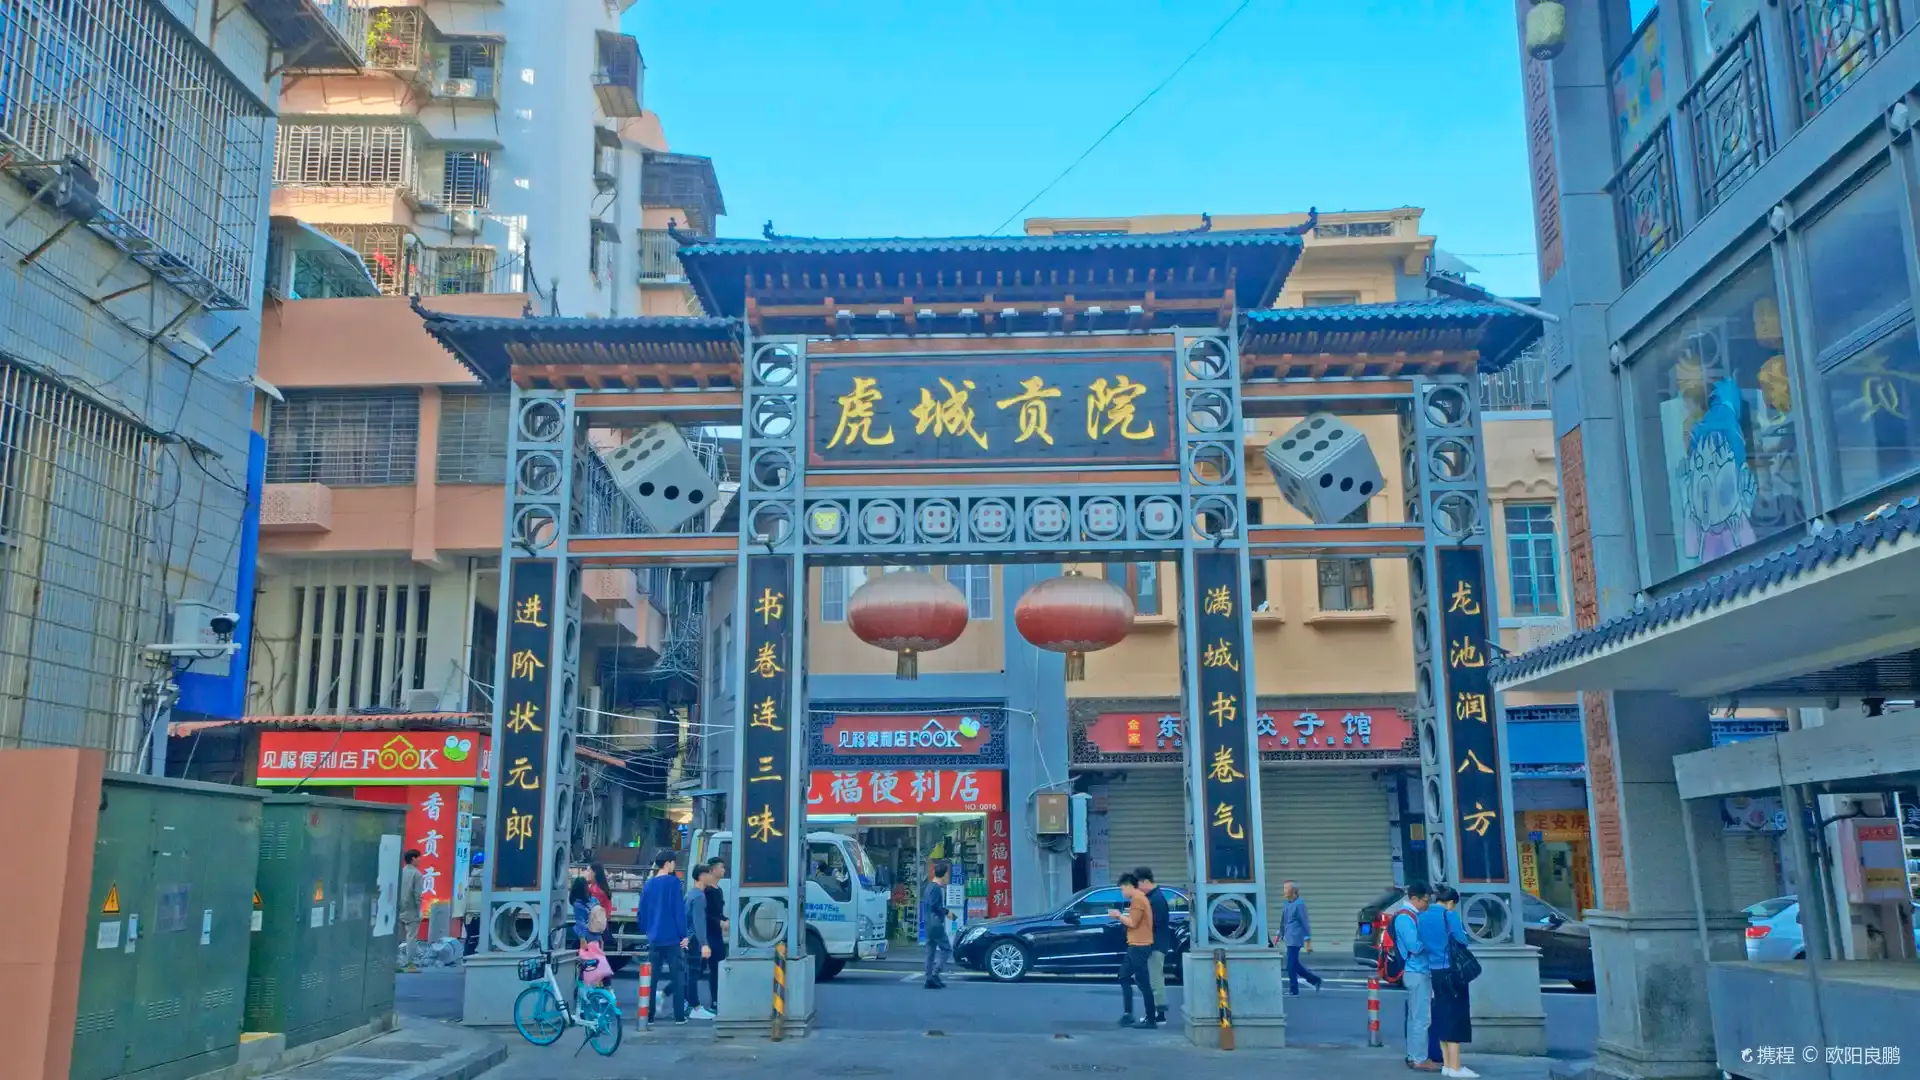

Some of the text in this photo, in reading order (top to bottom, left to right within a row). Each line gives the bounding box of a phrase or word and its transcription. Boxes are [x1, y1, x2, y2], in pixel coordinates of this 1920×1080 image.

[826, 375, 1155, 450] 虎城贡院
[261, 747, 439, 770] 见福便利店 FOOK
[504, 594, 548, 850] 进阶状元郎
[748, 588, 785, 843] 书卷连三味
[838, 729, 962, 748] 见福便利店 FOOK
[1203, 584, 1245, 839] 满城书卷气
[1448, 580, 1496, 837] 龙池润八方
